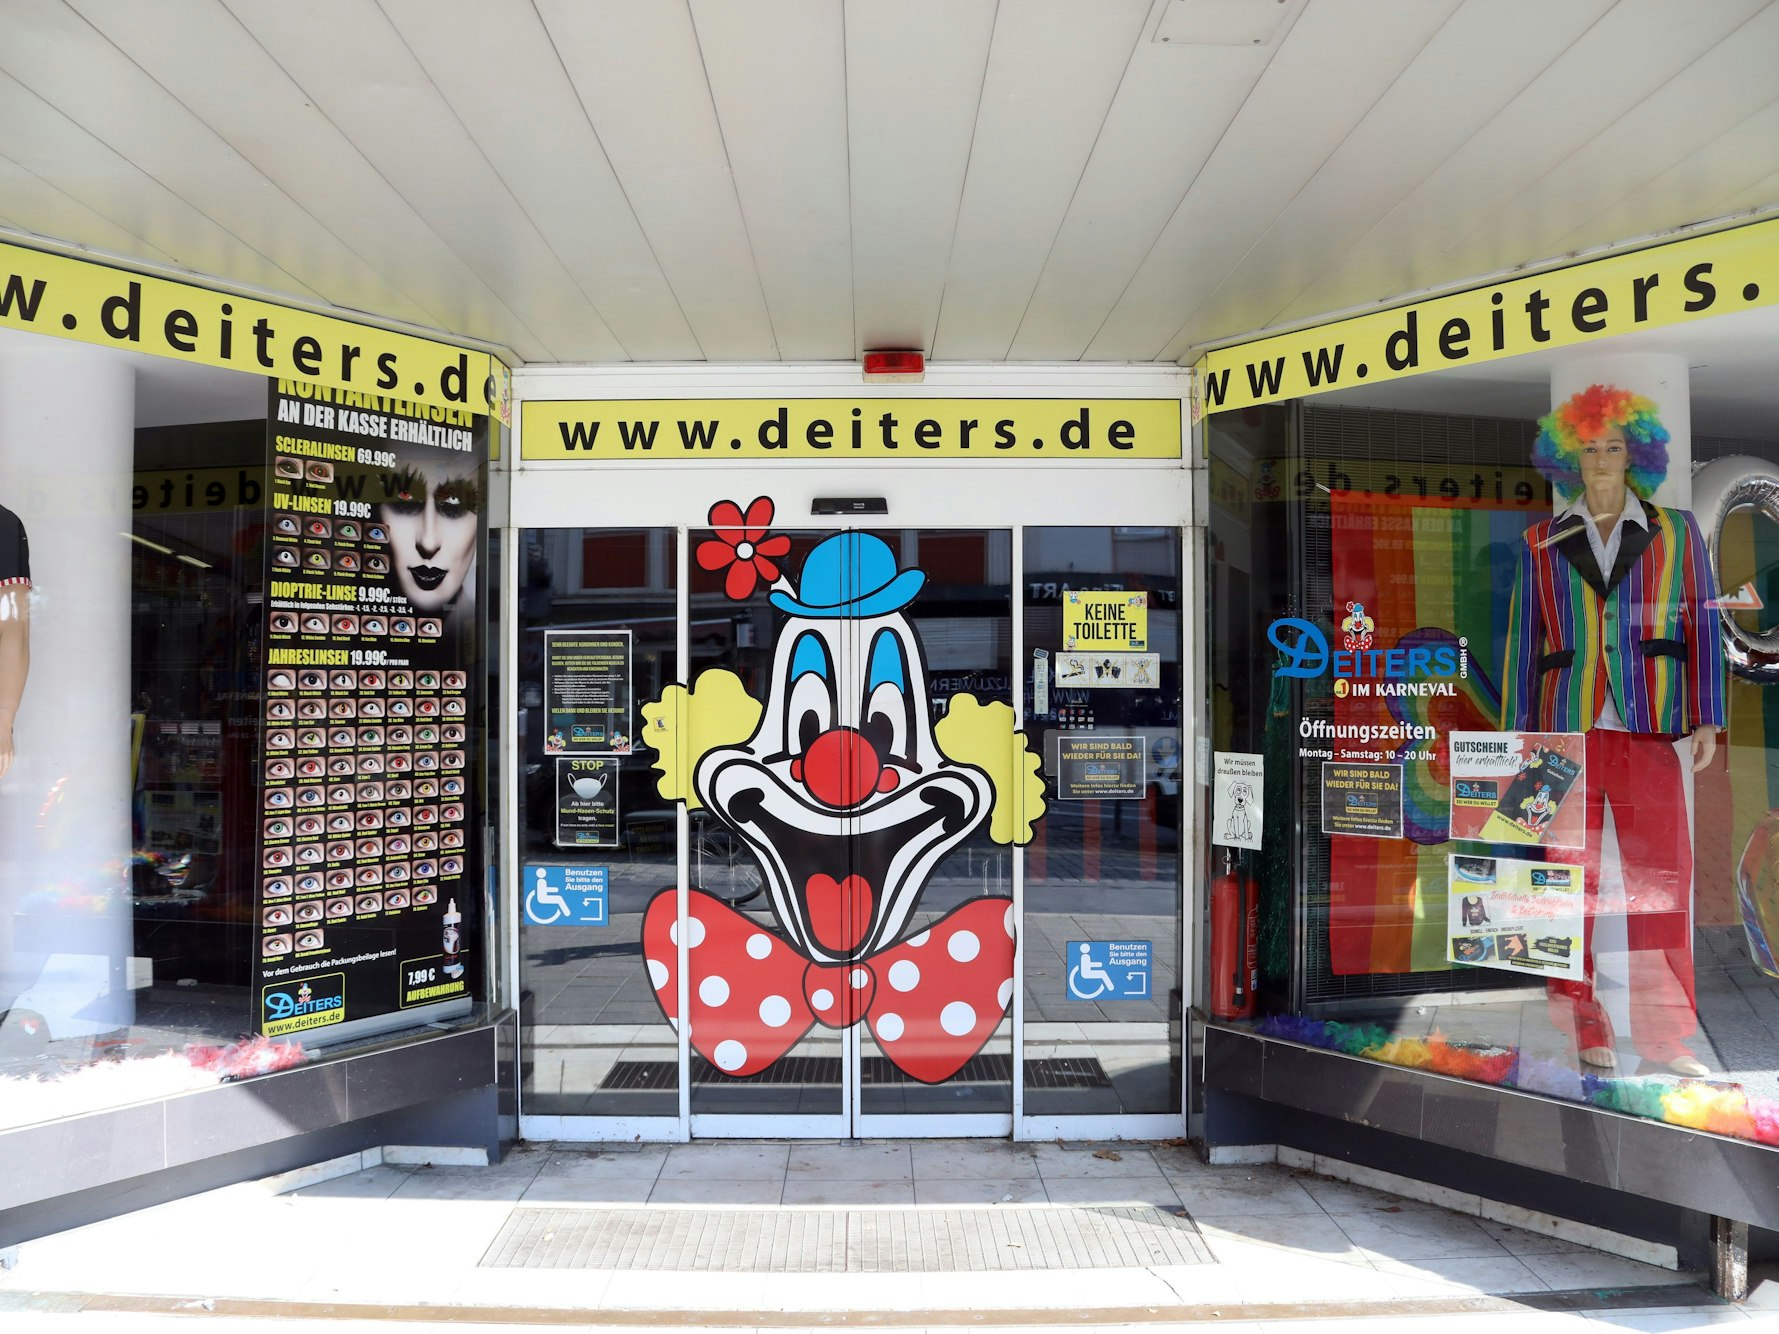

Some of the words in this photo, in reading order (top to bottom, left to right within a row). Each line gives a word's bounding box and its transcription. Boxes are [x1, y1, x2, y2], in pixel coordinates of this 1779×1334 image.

[277, 399, 300, 424] AN
[303, 402, 334, 430] DER
[338, 409, 387, 438] KASSE
[390, 418, 473, 452] ERHÄLTLICH
[559, 407, 1136, 452] www.deiters.de
[275, 435, 355, 463] SCLERALINSEN
[357, 448, 396, 468] 69.99€
[273, 493, 331, 514] UV-LINSEN
[333, 500, 371, 519] 19.99€
[271, 581, 357, 601] DIOPTRIE-LINSE
[359, 586, 390, 603] 9.99€
[1086, 604, 1126, 621] KEINE
[1074, 623, 1137, 640] TOILETTE
[1267, 618, 1457, 679] DEITERS
[268, 649, 349, 665] JAHRESLINSEN
[350, 650, 387, 666] 19.99€
[1353, 684, 1370, 696] IM
[1376, 683, 1457, 696] KARNEVAL
[1300, 717, 1436, 744] Öffnungszeiten
[1096, 751, 1111, 760] FÜR
[1300, 748, 1333, 760] Montag
[1341, 749, 1383, 761] Samstag:
[1386, 751, 1395, 760] 10
[1405, 751, 1416, 760] 20
[1419, 751, 1436, 761] Uhr
[1454, 742, 1508, 753] GUTSCHEINE
[572, 761, 604, 771] STOP
[1235, 759, 1256, 767] müssen
[1218, 768, 1241, 776] draußen
[1242, 769, 1263, 777] bleiben
[1334, 770, 1349, 778] WIR
[1350, 770, 1368, 778] SIND
[1370, 771, 1390, 779] BALD
[1326, 780, 1354, 789] WIEDER
[1356, 779, 1371, 790] FÜR
[1372, 782, 1384, 790] SIE
[1385, 783, 1398, 791] DA!
[565, 883, 603, 892] Ausgang
[263, 970, 274, 978] Vor
[275, 968, 290, 976] dem
[290, 962, 320, 973] Gebrauch
[321, 960, 330, 968] die
[331, 952, 379, 967] Packungsbeilage
[380, 948, 397, 958] lesen!
[1109, 958, 1147, 966] Ausgang
[406, 981, 465, 1003] AUFBEWAHRUNG
[265, 993, 342, 1020] DEITERS
[268, 1012, 340, 1034] www.deiters.de
